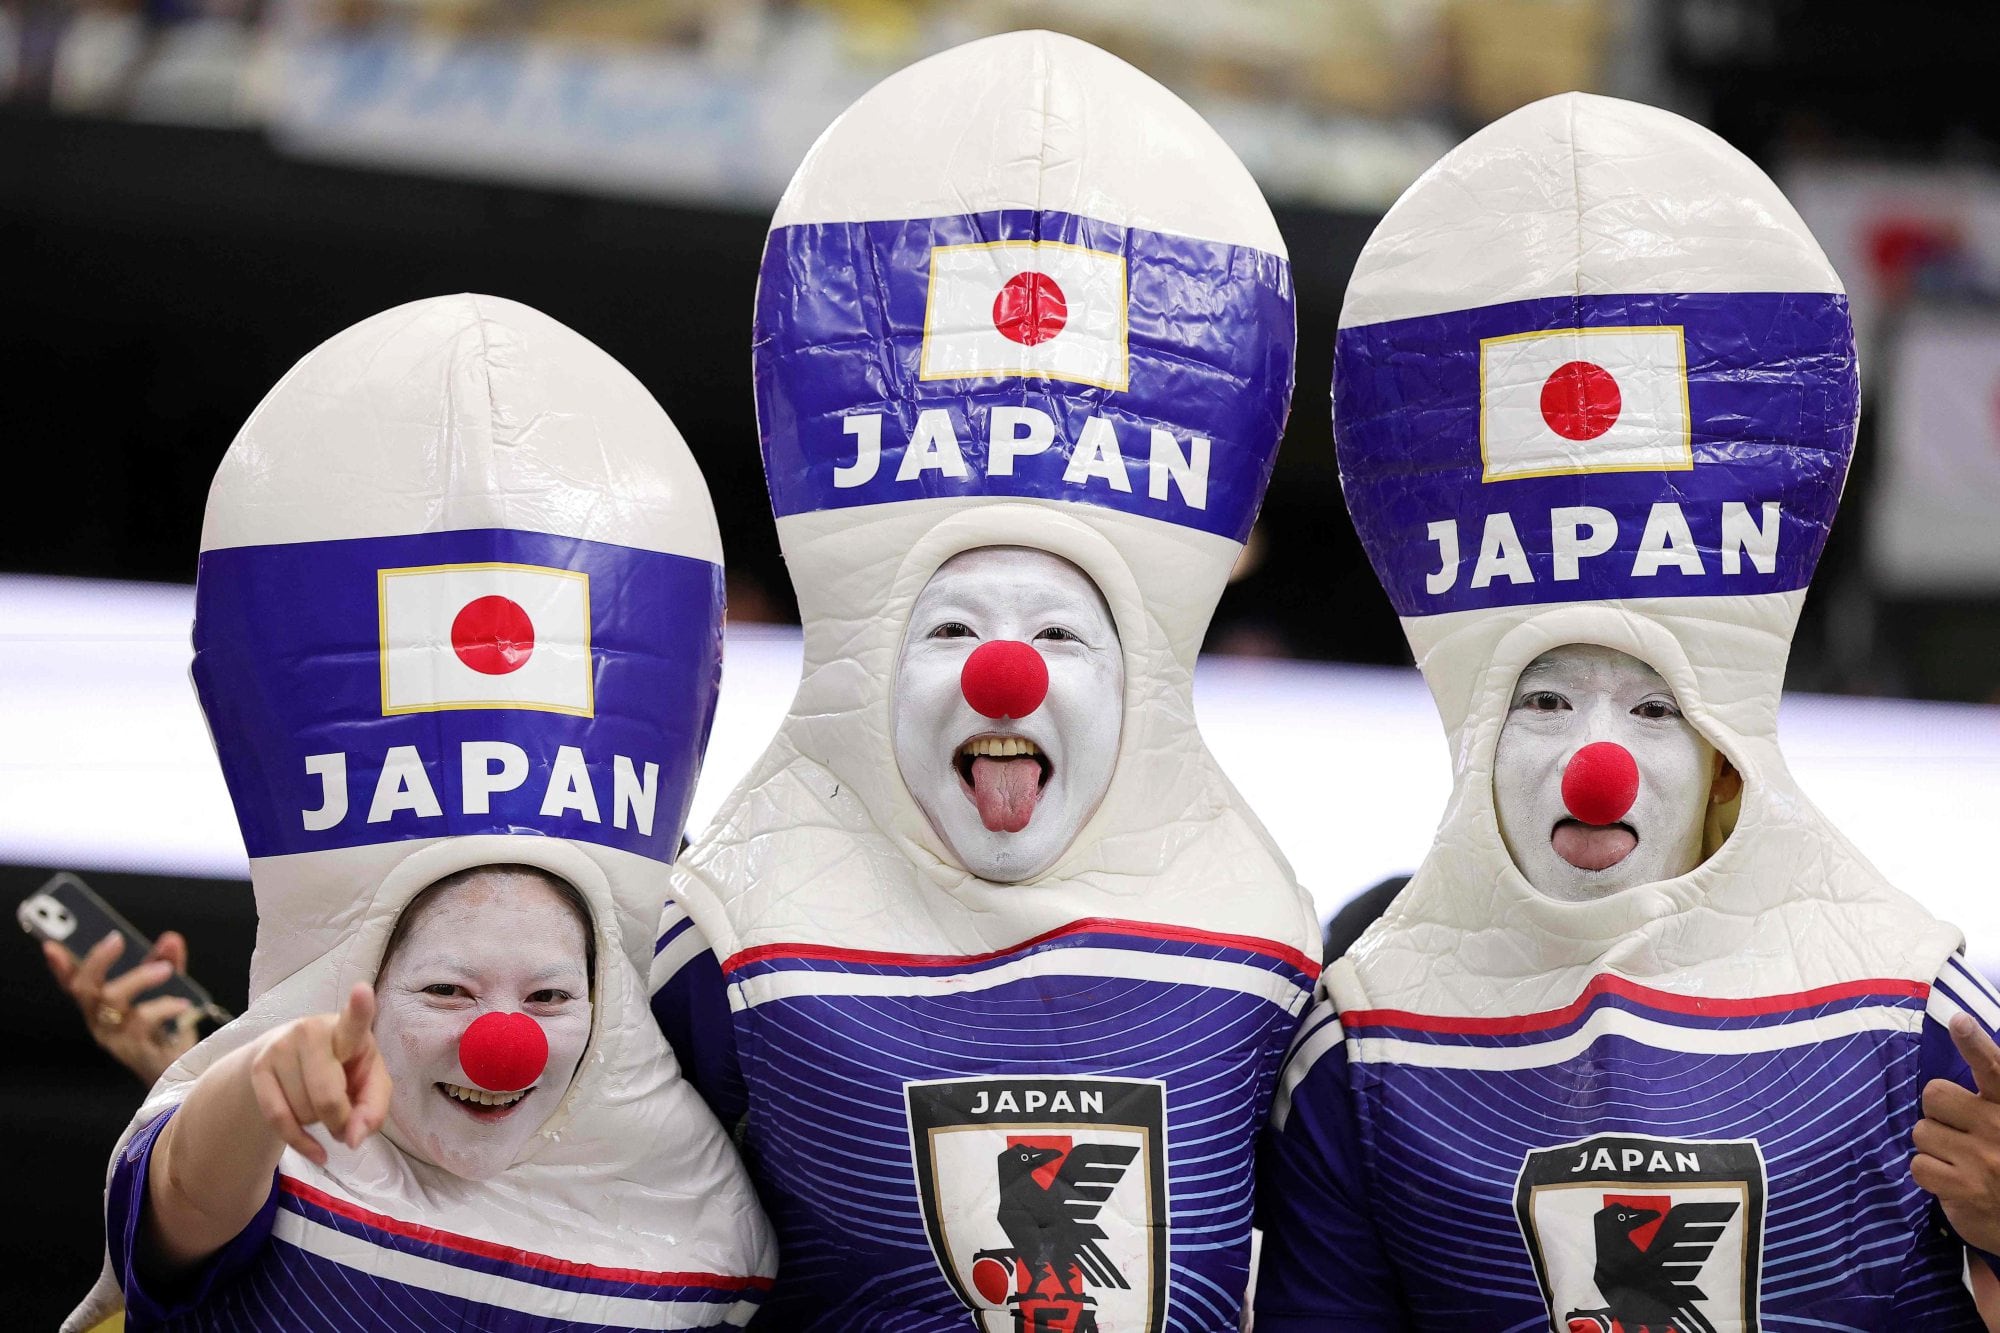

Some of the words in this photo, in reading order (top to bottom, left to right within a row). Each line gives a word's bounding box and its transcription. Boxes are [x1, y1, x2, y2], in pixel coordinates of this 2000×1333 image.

[832, 406, 1212, 511] JAPAN
[1426, 501, 1781, 595] JAPAN
[301, 741, 660, 837] JAPAN
[970, 1090, 1104, 1114] JAPAN
[1571, 1147, 1701, 1173] JAPAN
